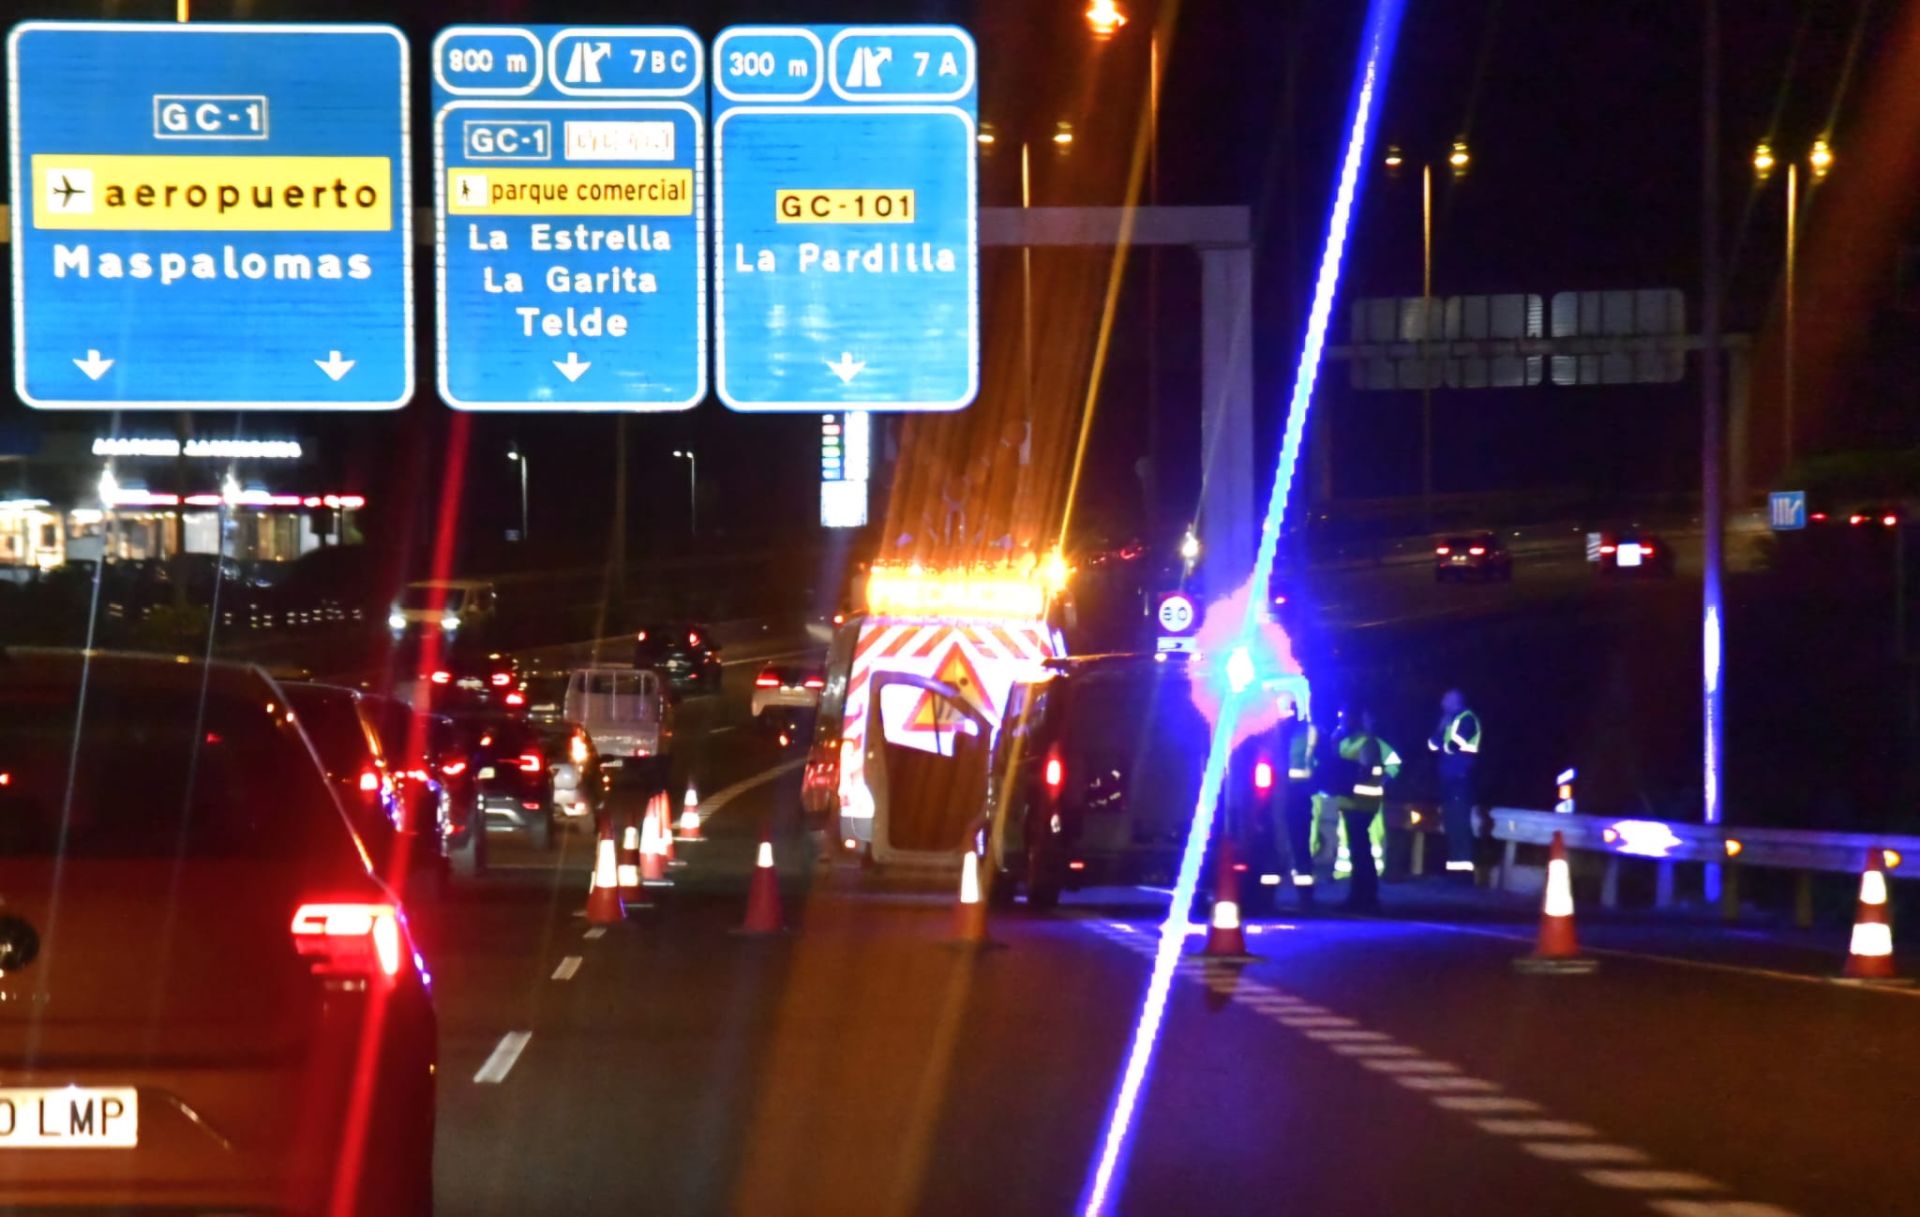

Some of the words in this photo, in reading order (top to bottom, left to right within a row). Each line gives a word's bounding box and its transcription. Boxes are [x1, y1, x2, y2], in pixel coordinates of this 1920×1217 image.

[448, 48, 494, 73] 800
[505, 53, 528, 73] m
[729, 51, 776, 77] 300
[787, 59, 808, 77] m
[162, 103, 261, 132] GC-1
[469, 127, 546, 154] GC-1
[106, 178, 377, 213] aeropuerto
[491, 183, 569, 204] parque
[577, 179, 687, 202] comercial
[781, 195, 911, 218] GC-101
[469, 223, 508, 251] La
[531, 223, 672, 251] Estrella
[53, 244, 372, 285] Maspalomas
[736, 243, 776, 273] La
[799, 242, 956, 273] Pardilla
[484, 266, 524, 294] La
[546, 265, 658, 294] Garita
[515, 306, 629, 338] Telde
[39, 1097, 124, 1136] LMP
